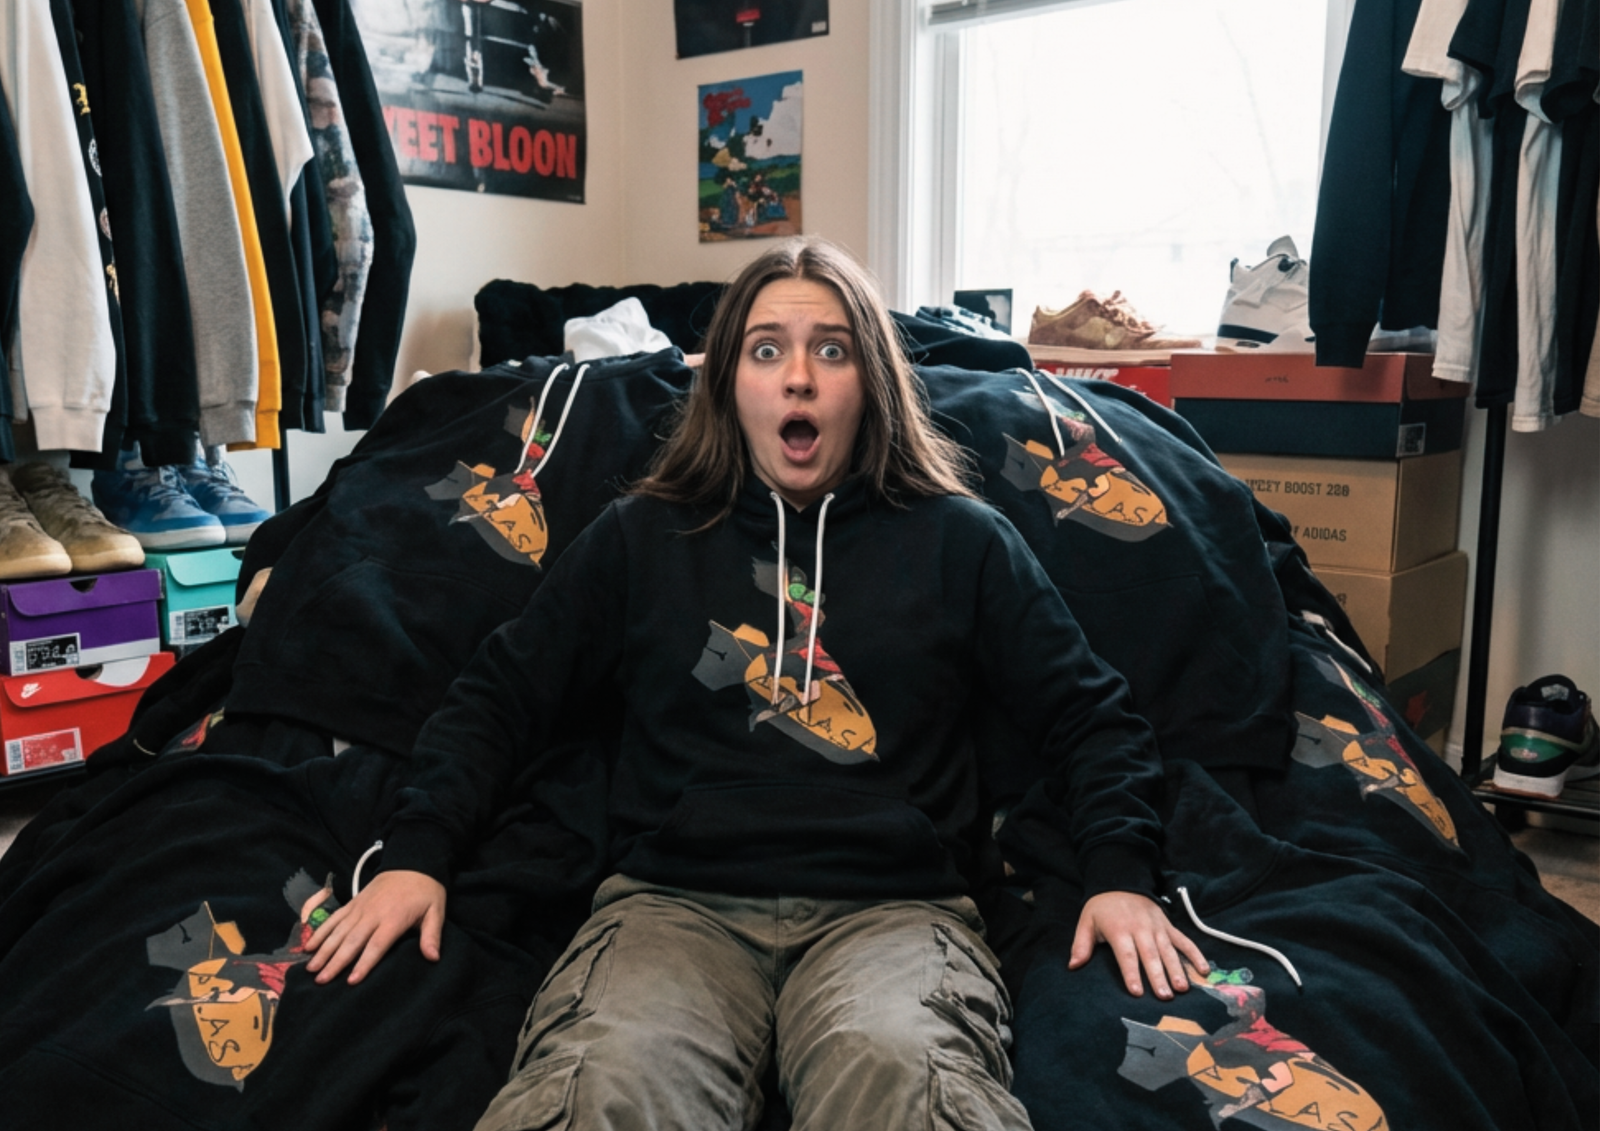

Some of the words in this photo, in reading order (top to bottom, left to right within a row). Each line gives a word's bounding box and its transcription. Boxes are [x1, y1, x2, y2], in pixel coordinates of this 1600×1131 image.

[468, 118, 577, 179] BLOON
[1284, 481, 1322, 496] BOOST
[1302, 526, 1347, 542] ADIDAS
